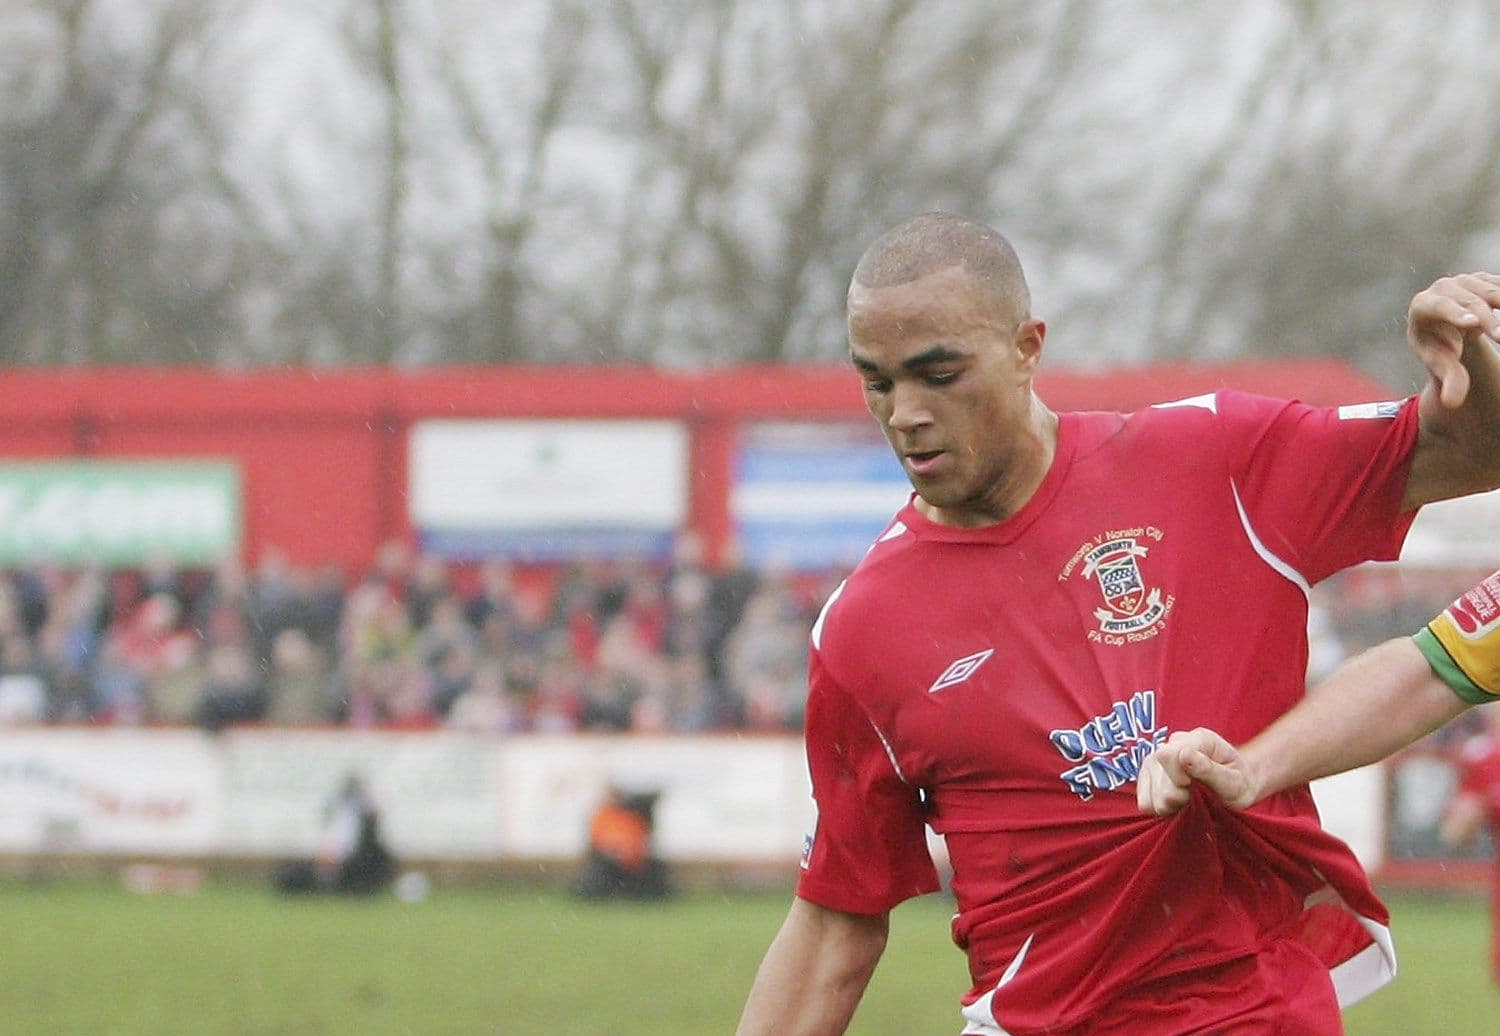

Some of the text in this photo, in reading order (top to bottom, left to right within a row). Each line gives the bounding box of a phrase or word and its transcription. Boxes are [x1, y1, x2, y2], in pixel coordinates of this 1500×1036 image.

[1058, 541, 1093, 581] Tamworth
[1105, 527, 1144, 540] Norwich
[1145, 526, 1164, 541] City
[1087, 629, 1102, 643] FA
[1104, 634, 1124, 646] Cup
[1127, 625, 1158, 643] Round
[1158, 620, 1166, 630] 3
[1104, 617, 1143, 630] FOOTBALL
